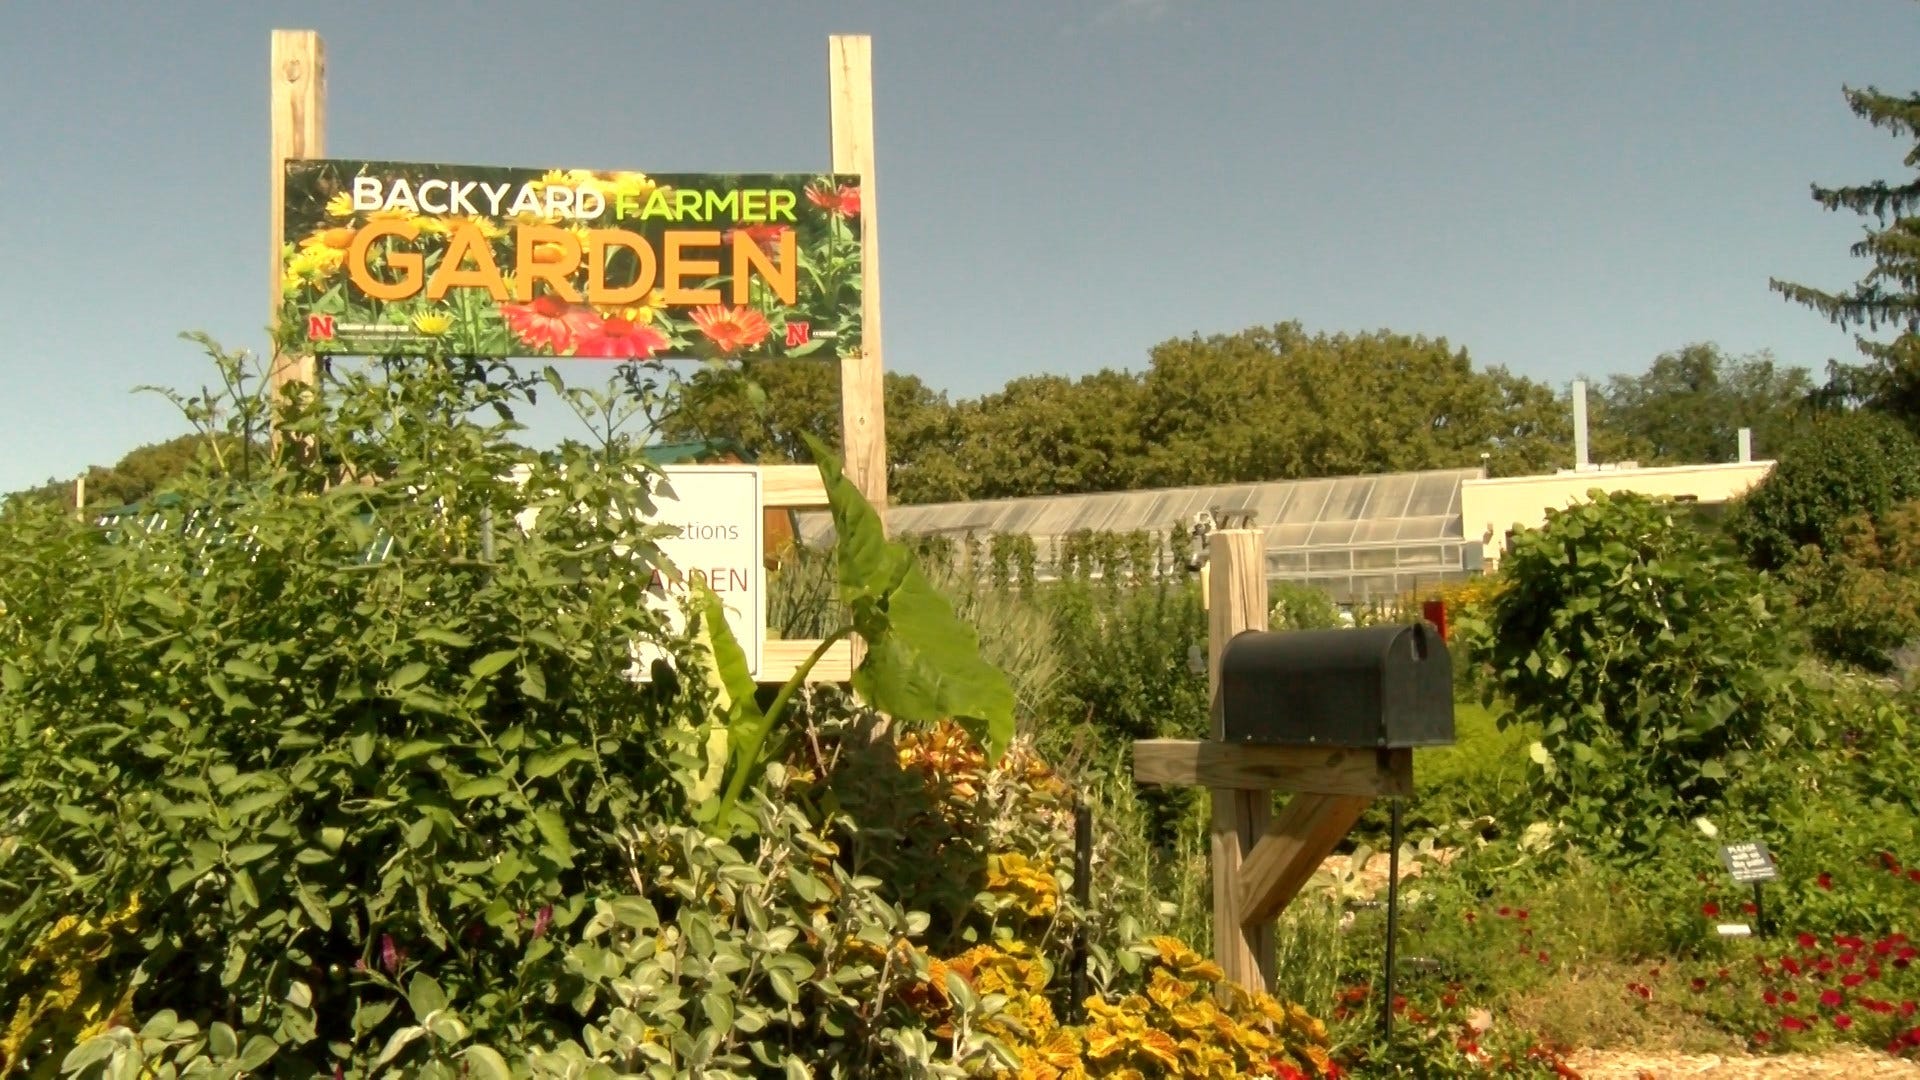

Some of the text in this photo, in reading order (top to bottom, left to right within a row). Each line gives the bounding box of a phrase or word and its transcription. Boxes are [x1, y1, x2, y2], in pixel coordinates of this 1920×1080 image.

[353, 176, 797, 222] BACKYARD FARMER
[349, 218, 797, 306] GARDEN
[309, 314, 334, 341] N
[785, 321, 810, 347] N
[665, 521, 739, 540] ctions
[646, 567, 748, 592] ARDEN
